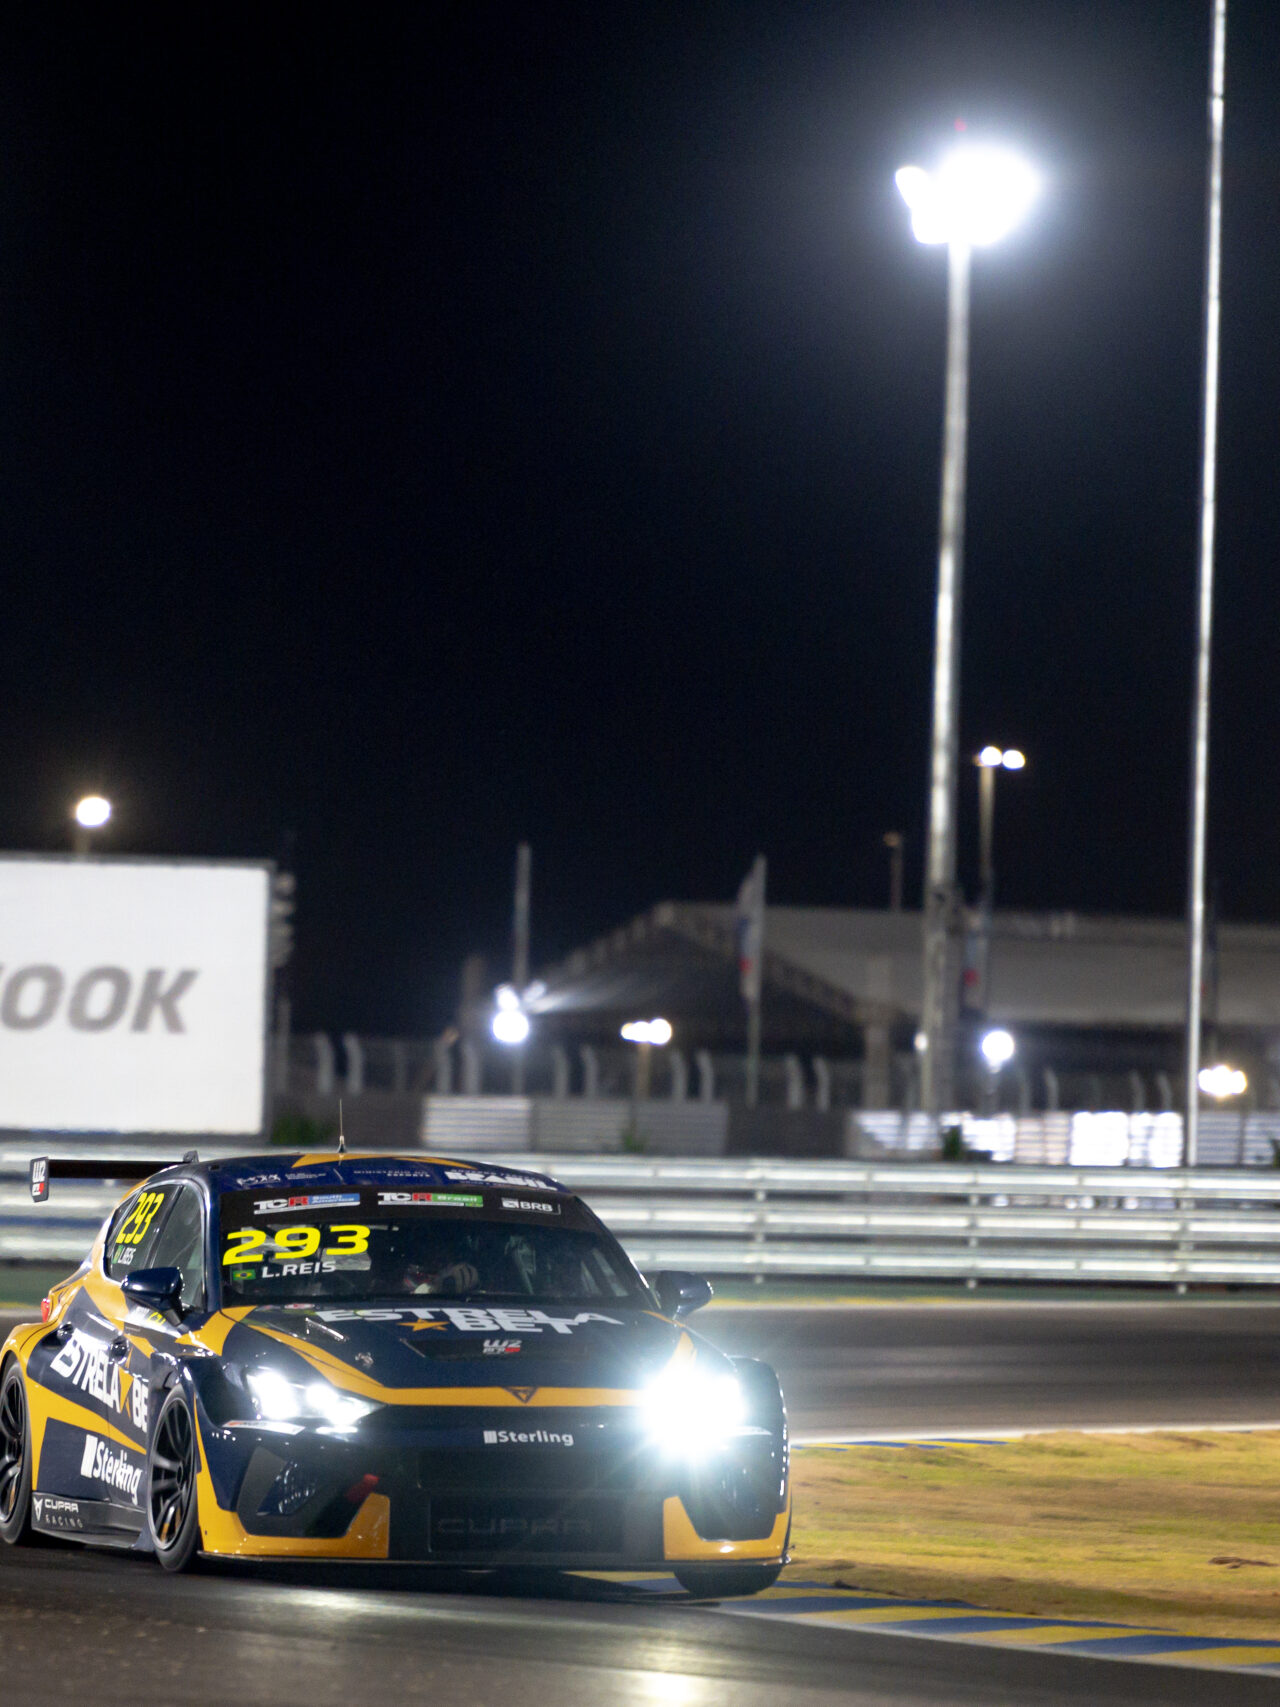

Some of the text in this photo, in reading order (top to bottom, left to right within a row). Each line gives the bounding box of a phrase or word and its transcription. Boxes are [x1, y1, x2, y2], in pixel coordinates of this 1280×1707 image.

[254, 1195, 309, 1211] TCR
[378, 1192, 478, 1203] TCR Brasil
[520, 1202, 553, 1212] BRB
[116, 1192, 165, 1244] 293
[222, 1224, 371, 1265] 293
[261, 1260, 338, 1278] L.REIS
[315, 1307, 625, 1325] ESTRELA
[448, 1317, 574, 1335] BET
[497, 1430, 575, 1447] Sterling
[92, 1441, 144, 1506] Sterling
[44, 1498, 80, 1513] CUPRA
